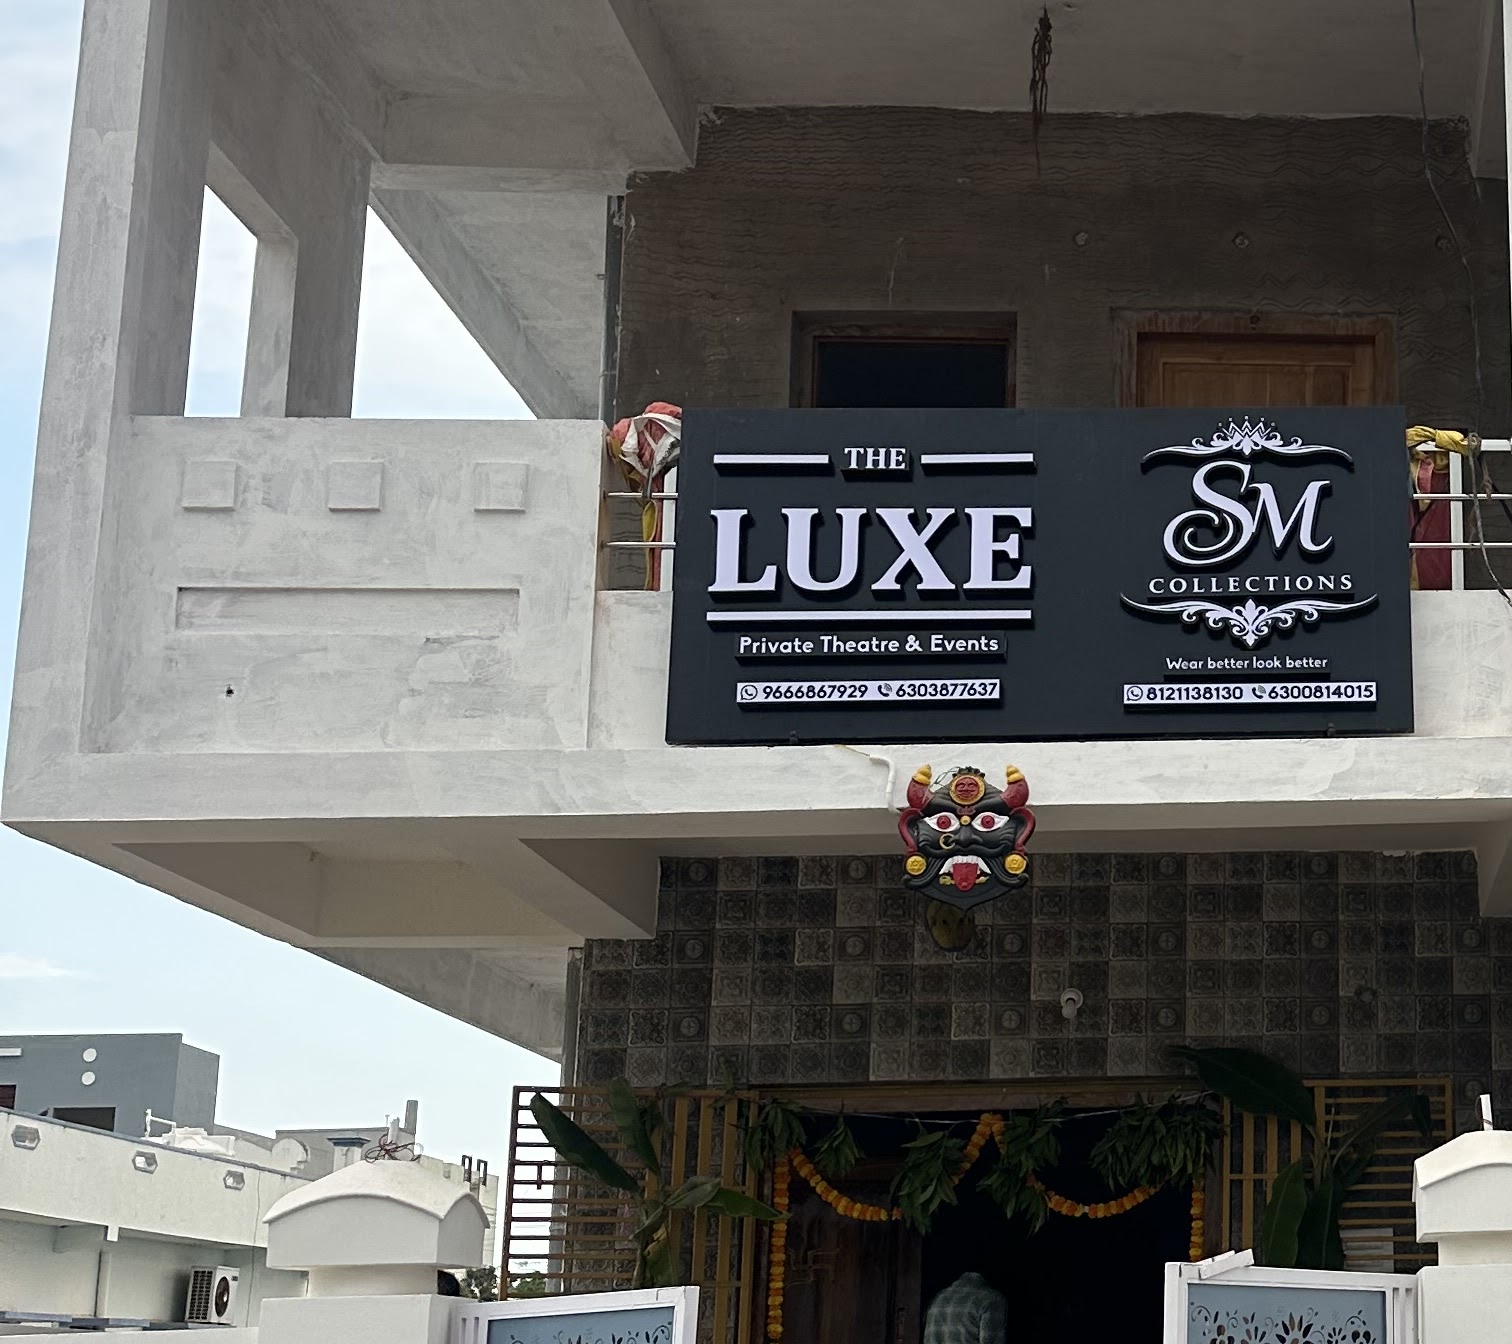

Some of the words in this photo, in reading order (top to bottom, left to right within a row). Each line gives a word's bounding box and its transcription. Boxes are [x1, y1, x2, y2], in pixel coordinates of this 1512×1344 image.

[844, 447, 906, 470] THE
[1163, 460, 1333, 565] SM
[708, 507, 1032, 591] LUXE
[1148, 574, 1353, 594] COLLECTIONS
[739, 636, 814, 654] Private
[820, 635, 900, 654] Theatre
[904, 634, 923, 653] &
[930, 633, 999, 652] Events
[1165, 656, 1204, 670] Wear
[1207, 656, 1249, 669] better
[1252, 655, 1283, 669] look
[1285, 655, 1328, 669] better
[762, 684, 868, 701] 9666867929
[895, 682, 998, 699] 6303877637
[1146, 685, 1244, 701] 8121138130
[1268, 684, 1374, 700] 6300814015
